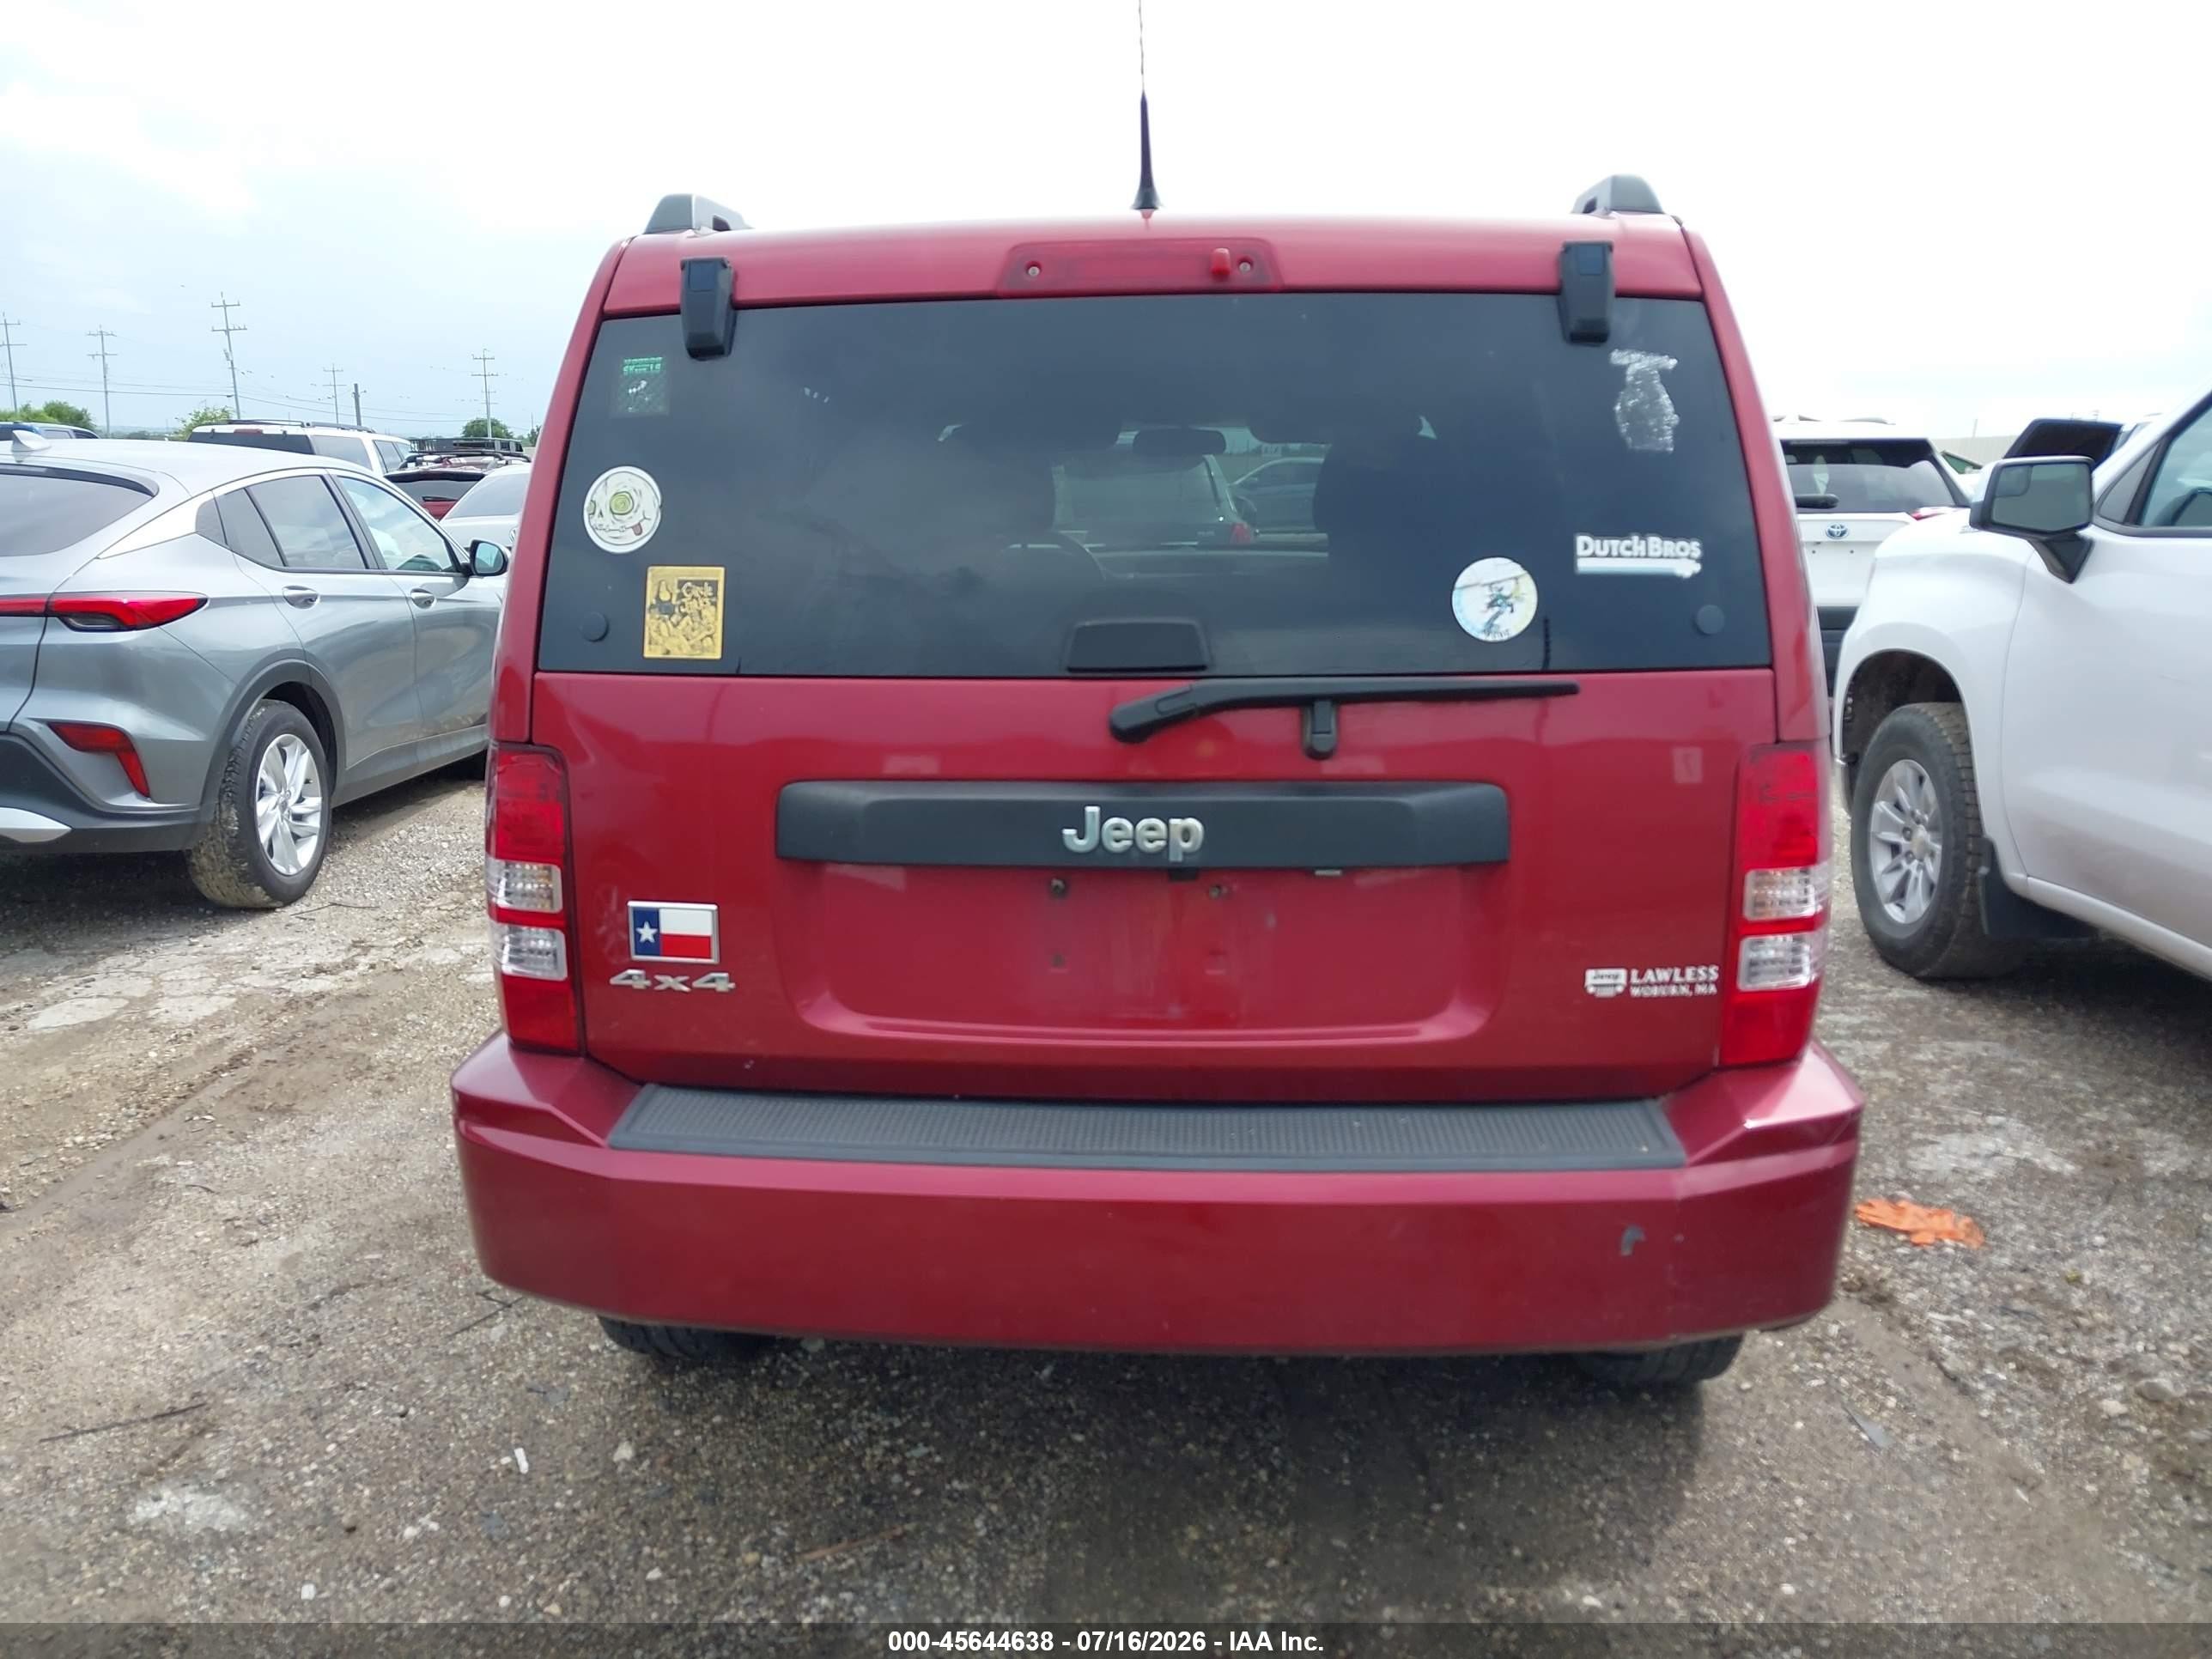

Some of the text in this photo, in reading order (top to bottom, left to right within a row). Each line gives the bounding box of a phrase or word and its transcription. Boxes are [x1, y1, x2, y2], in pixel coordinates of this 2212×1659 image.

[1062, 806, 1204, 862] Jeep
[610, 969, 736, 992] 4x4
[1630, 966, 1719, 983] LAWLESS
